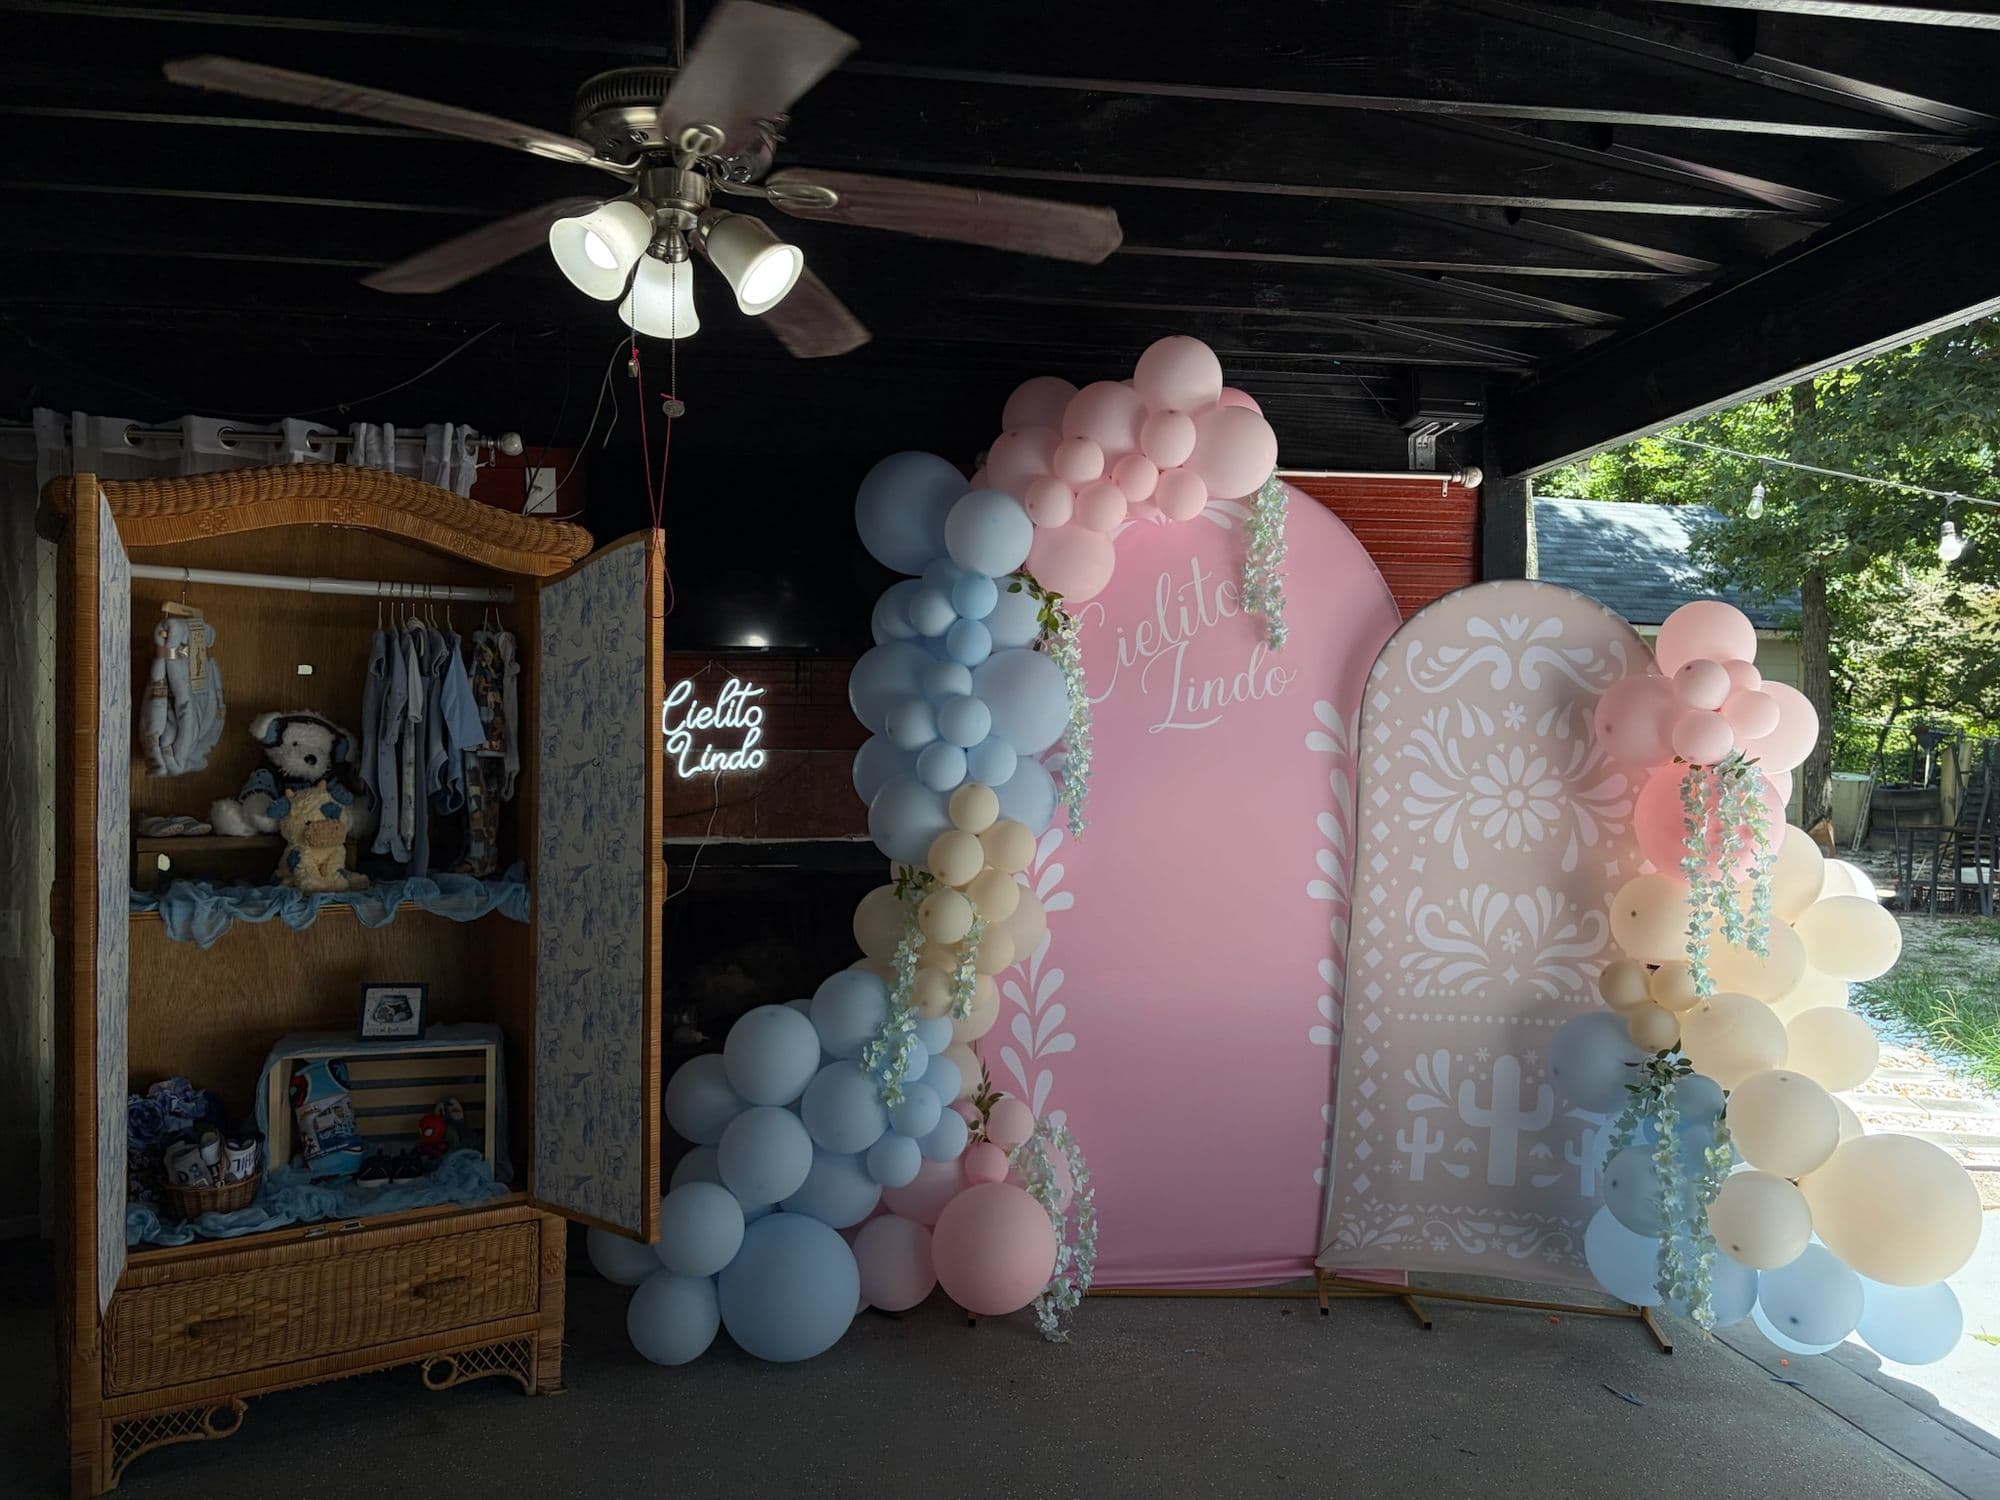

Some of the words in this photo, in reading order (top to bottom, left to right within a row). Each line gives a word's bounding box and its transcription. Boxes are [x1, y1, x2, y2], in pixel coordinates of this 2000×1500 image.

[662, 678, 765, 736] Cielito
[1141, 640, 1298, 734] Lindo
[666, 726, 765, 778] Lindo
